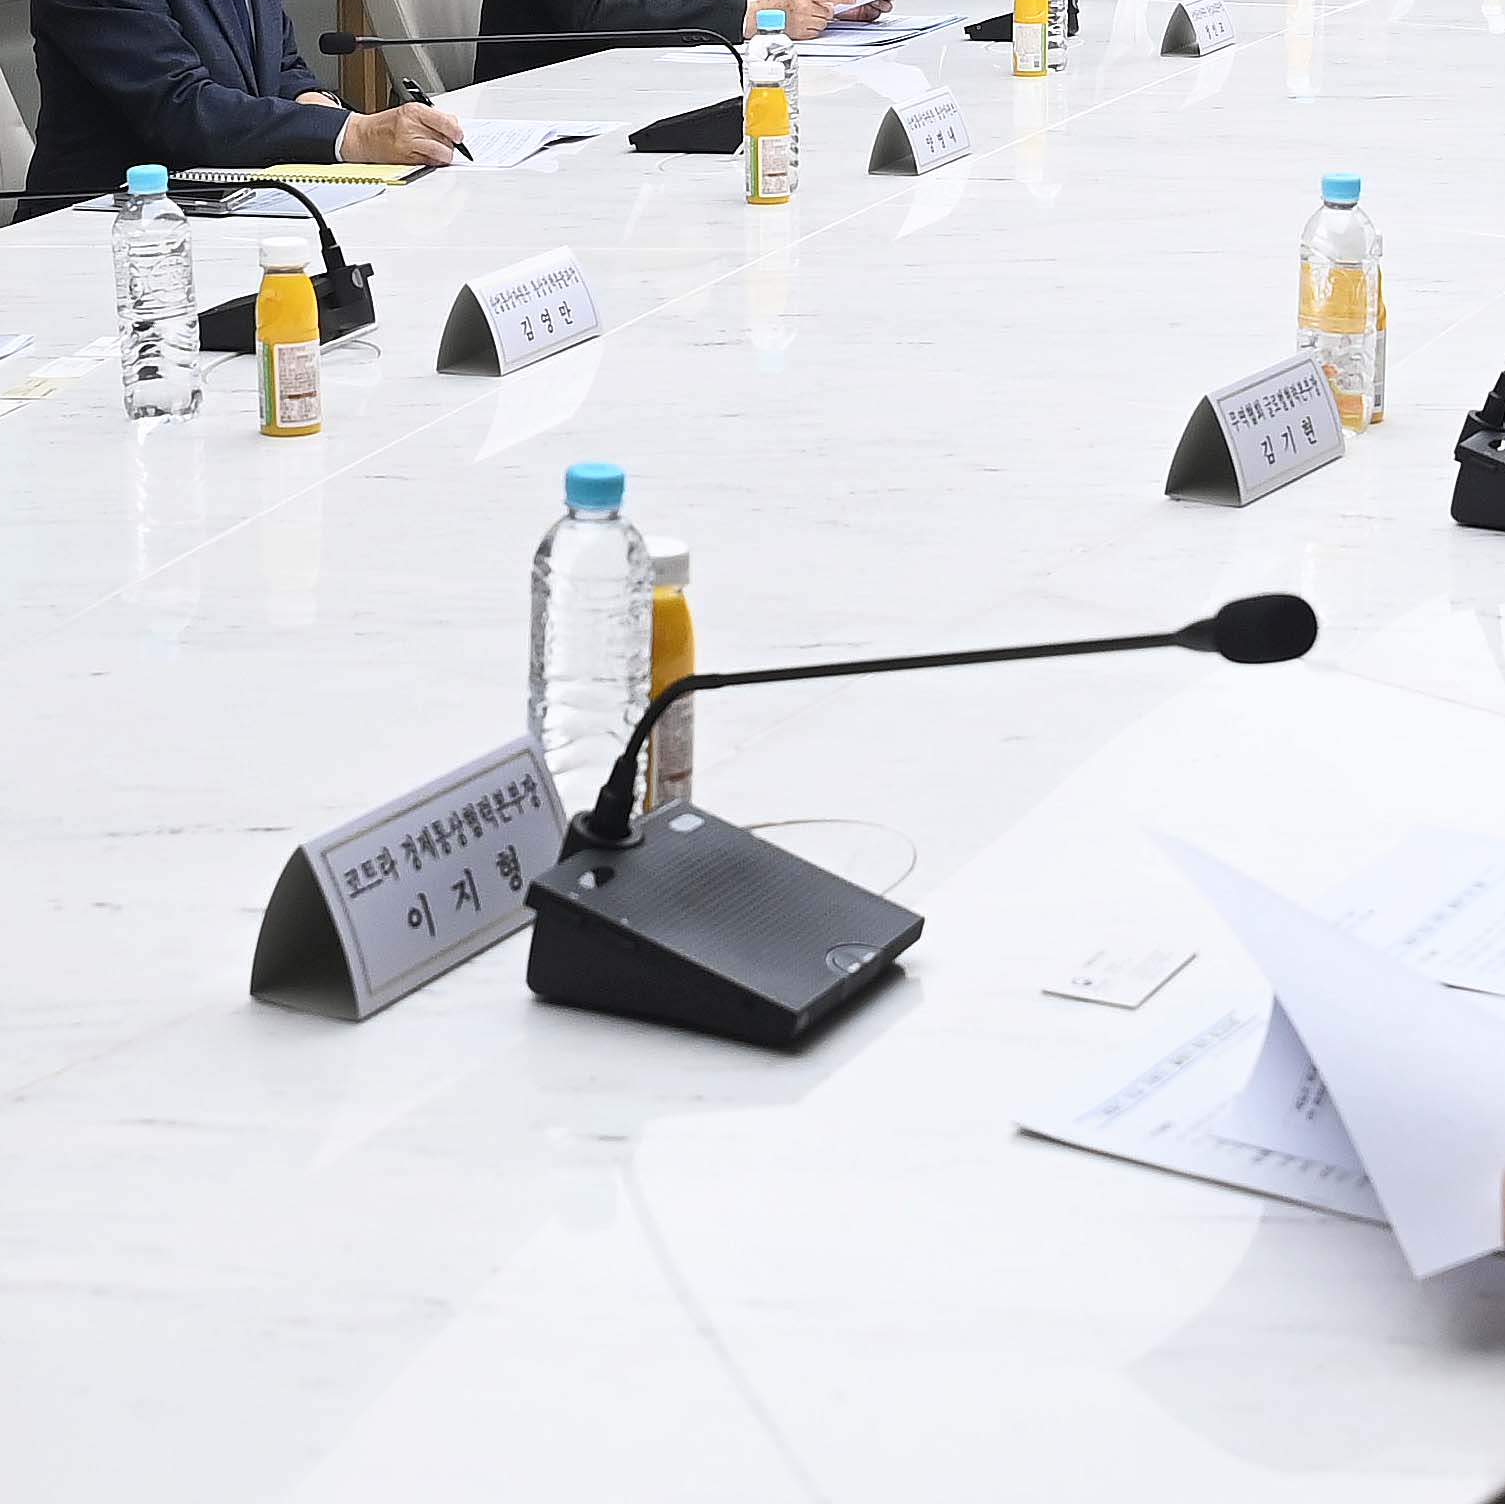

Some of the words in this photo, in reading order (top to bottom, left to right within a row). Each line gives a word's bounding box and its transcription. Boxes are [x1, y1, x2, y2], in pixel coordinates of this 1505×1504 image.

[520, 300, 574, 342] 김영만
[1260, 415, 1318, 465] 김기현
[344, 846, 400, 899] 코트라
[407, 844, 523, 937] 이지형
